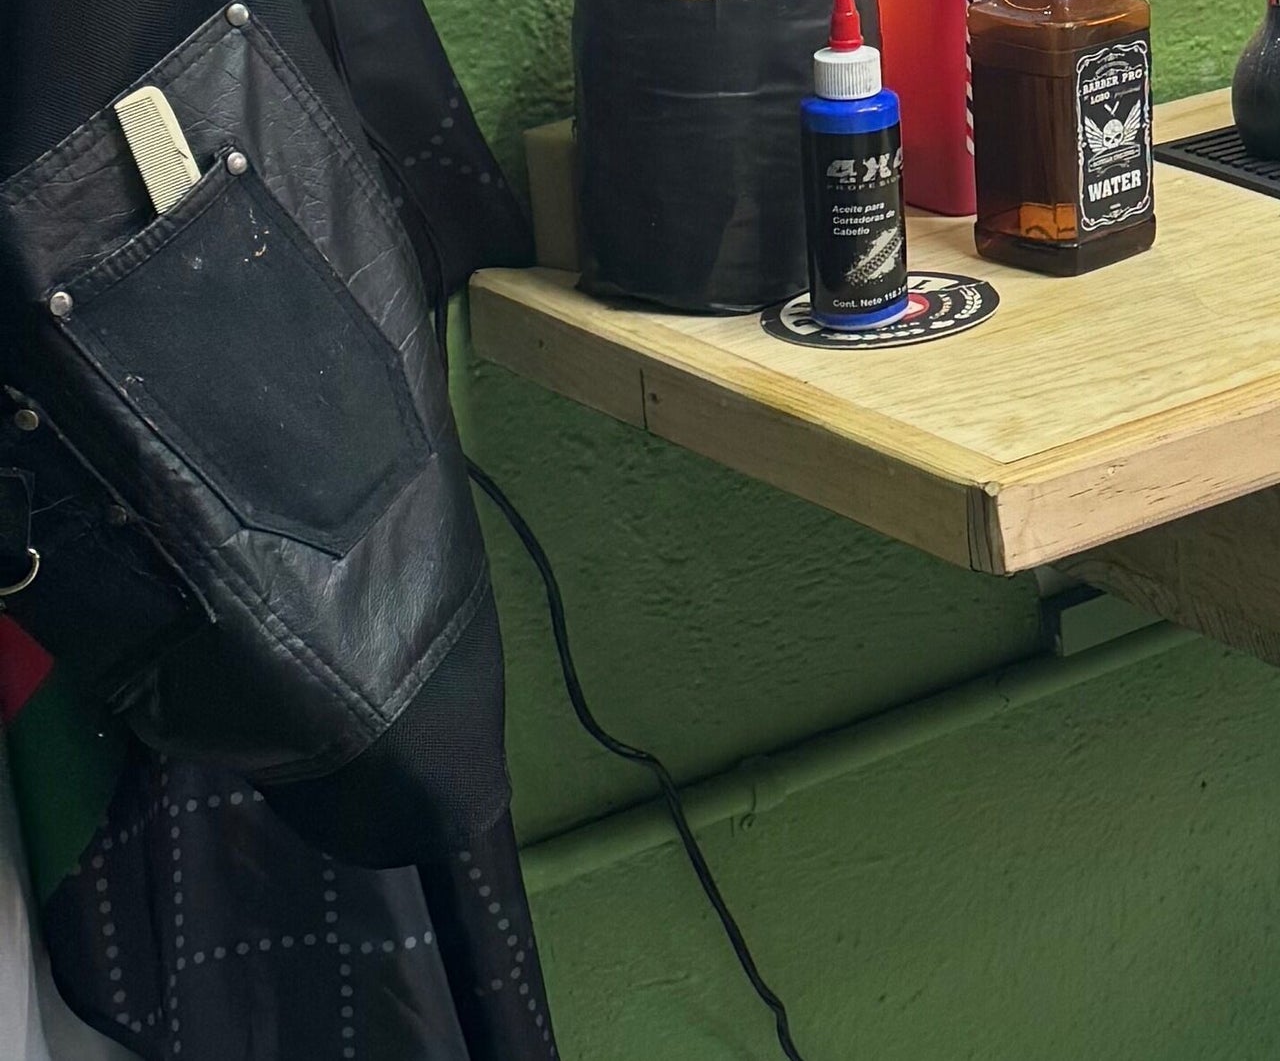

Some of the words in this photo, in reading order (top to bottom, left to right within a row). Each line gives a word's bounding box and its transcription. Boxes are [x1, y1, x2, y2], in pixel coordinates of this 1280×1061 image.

[1082, 75, 1119, 95] BARBER
[1121, 68, 1143, 84] PRO
[1087, 169, 1142, 202] WATER
[832, 204, 863, 214] Aceite
[864, 201, 885, 214] para
[833, 213, 885, 225] Cortadoras
[833, 226, 870, 236] Cabello
[860, 297, 883, 308] Neto
